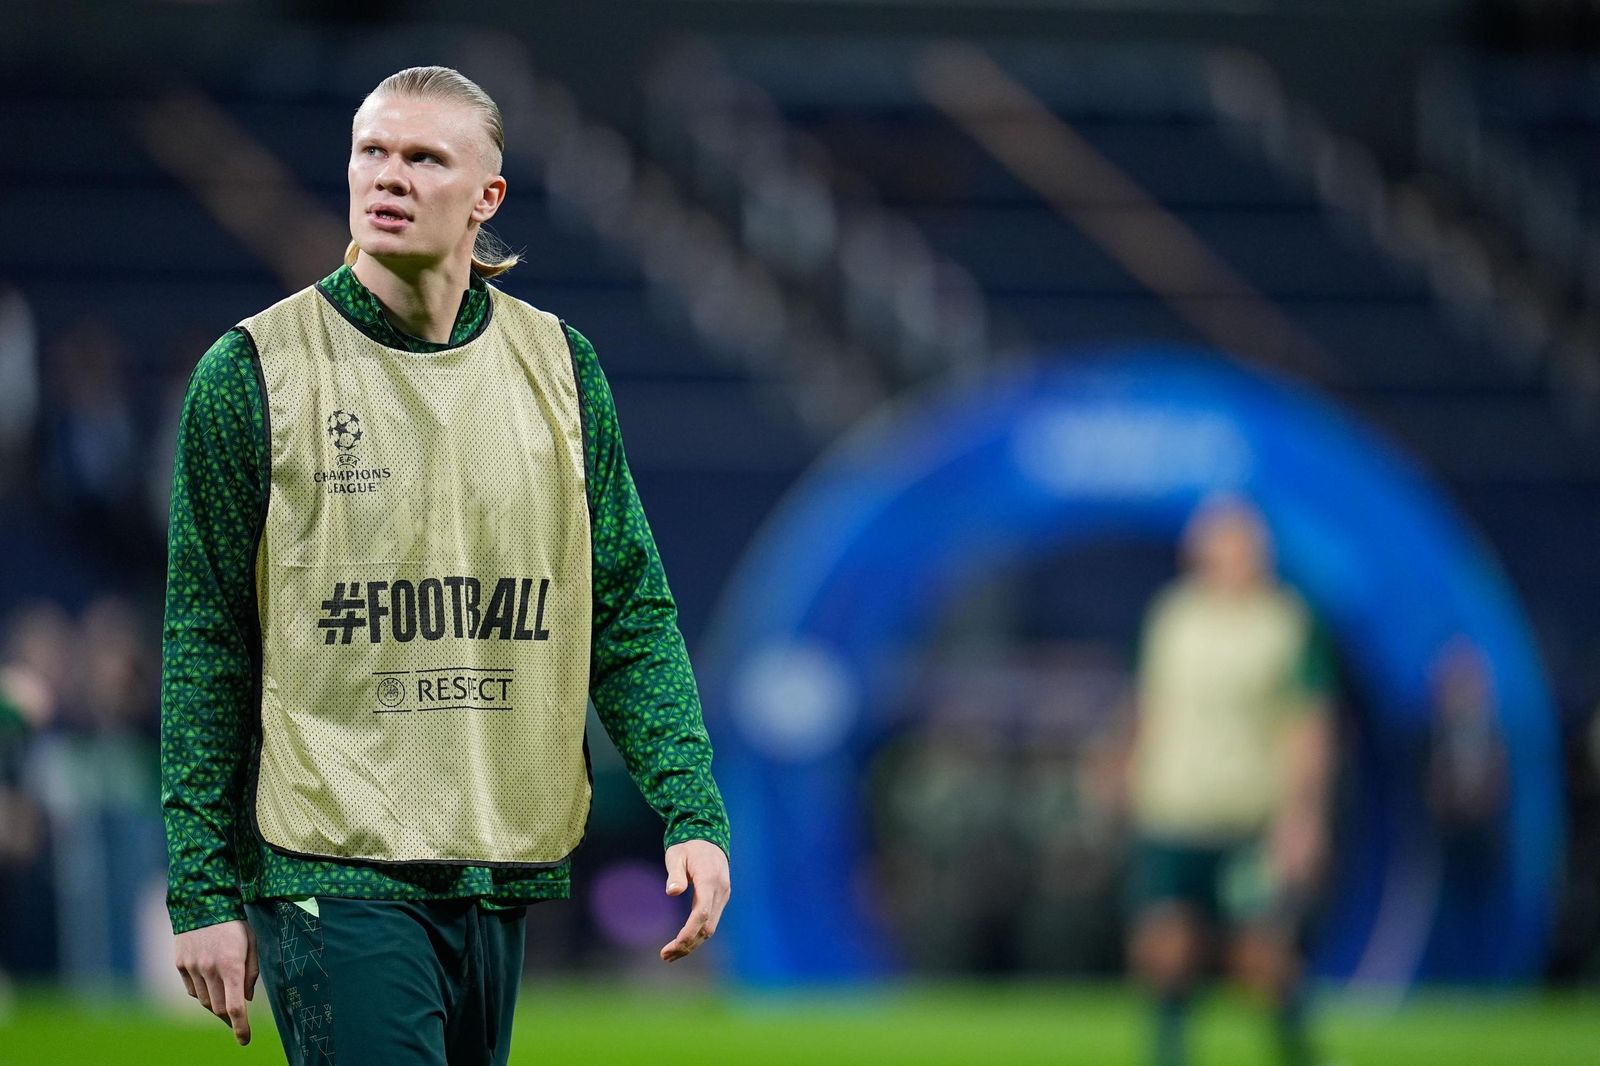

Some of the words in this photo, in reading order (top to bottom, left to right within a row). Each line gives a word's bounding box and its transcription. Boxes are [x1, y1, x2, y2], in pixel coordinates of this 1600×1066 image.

[313, 467, 391, 483] CHAMPIONS
[327, 482, 377, 494] LEAGUE
[317, 576, 550, 645] #FOOTBALL
